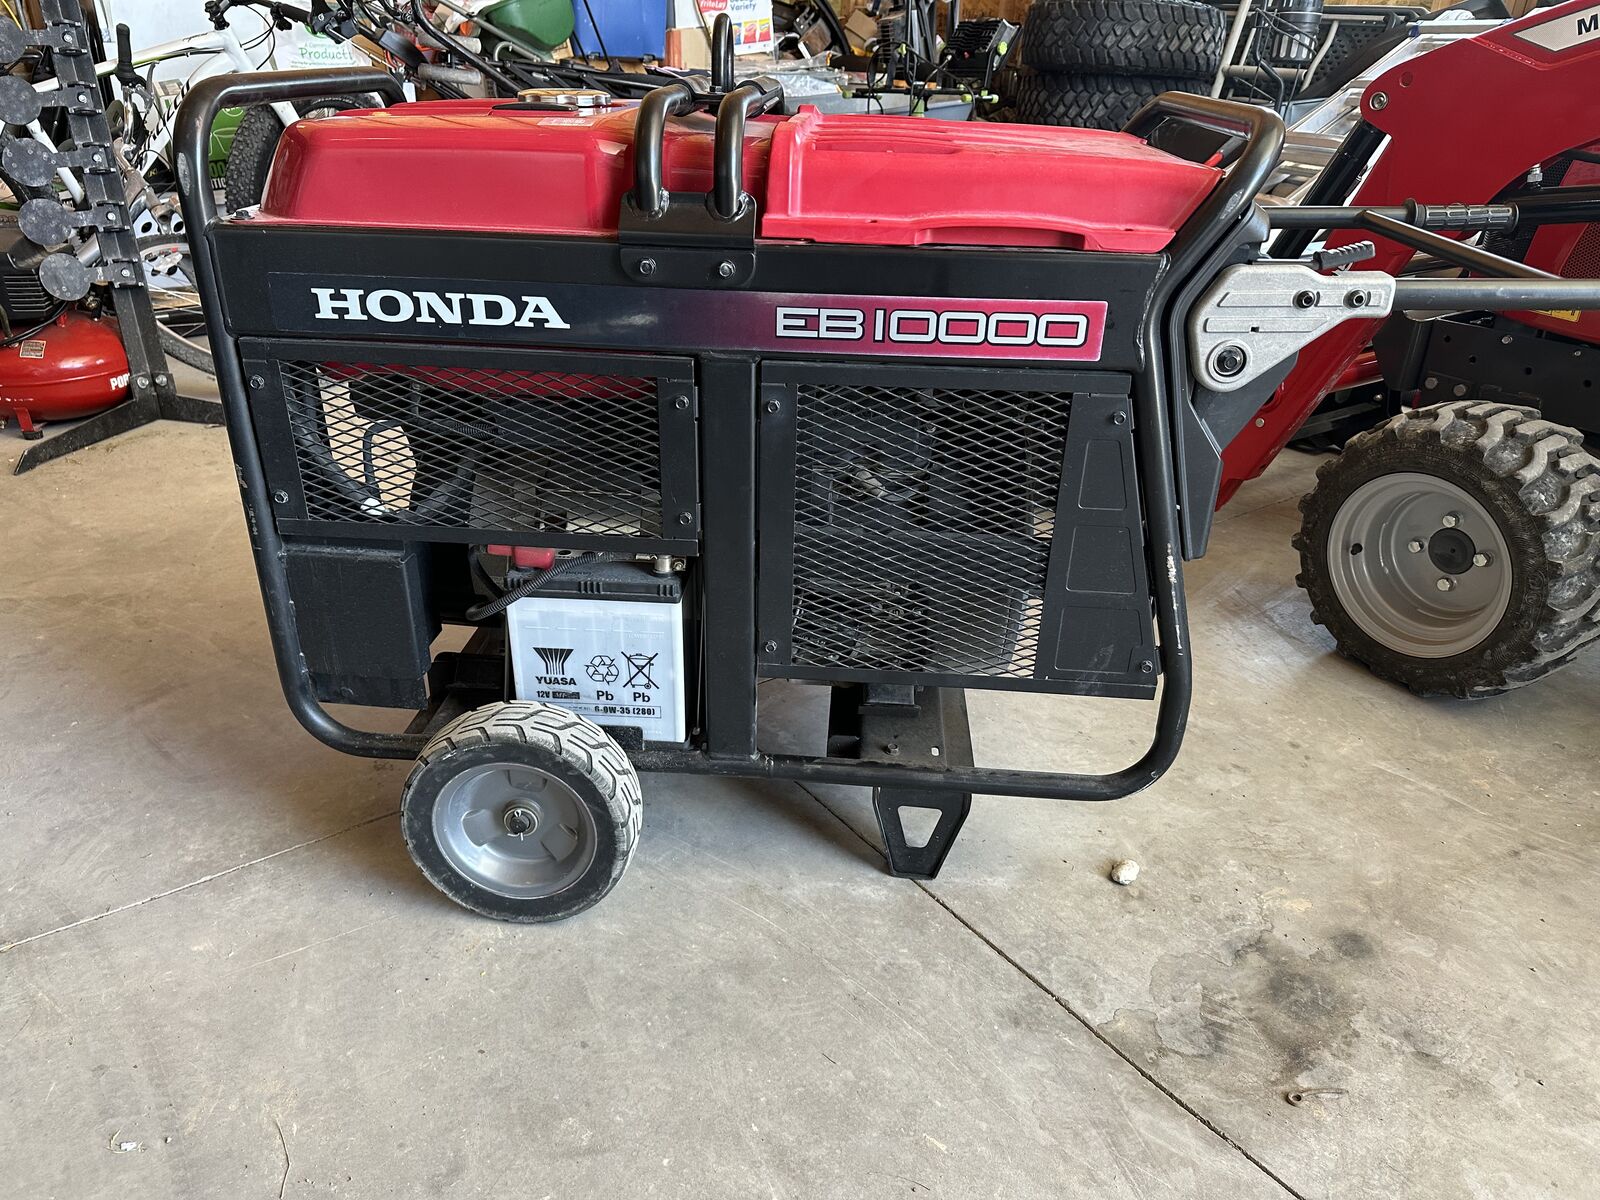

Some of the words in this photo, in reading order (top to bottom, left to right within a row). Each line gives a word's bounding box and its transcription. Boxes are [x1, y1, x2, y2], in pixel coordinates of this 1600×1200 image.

[731, 2, 757, 11] Variety
[311, 287, 571, 329] HONDA
[776, 306, 1089, 346] EB10000
[110, 372, 130, 391] POR
[536, 676, 577, 686] YUASA
[537, 690, 550, 698] 12V
[597, 690, 614, 700] Pb
[633, 692, 651, 702] Pb
[633, 707, 656, 716] (280)
